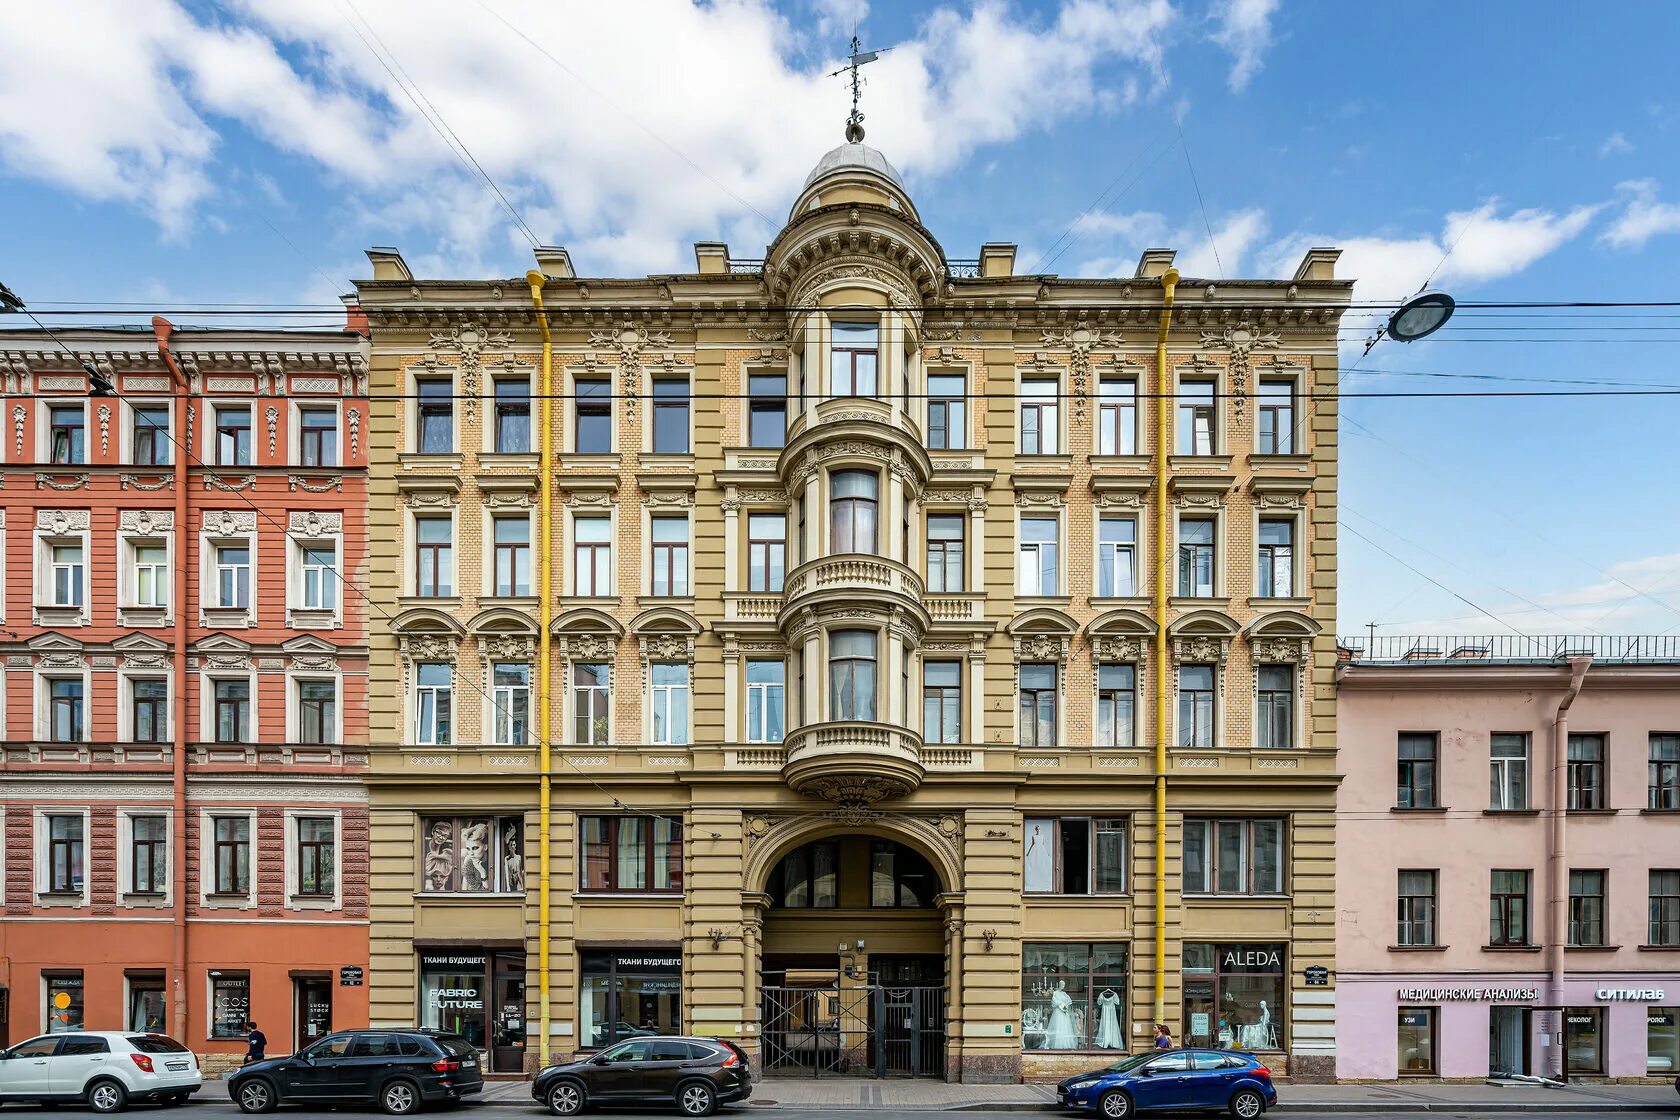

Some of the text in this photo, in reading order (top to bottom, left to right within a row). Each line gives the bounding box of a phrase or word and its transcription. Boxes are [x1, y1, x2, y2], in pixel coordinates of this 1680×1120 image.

[643, 959, 681, 967] БУДУЩЕГО
[1224, 952, 1280, 966] ALEDA
[429, 988, 477, 997] FABRIC
[1399, 988, 1538, 1000] МЕДИЦИНСКИЕ АНАЛИЗЫ
[220, 997, 248, 1007] COS
[429, 1000, 483, 1009] FUTURE
